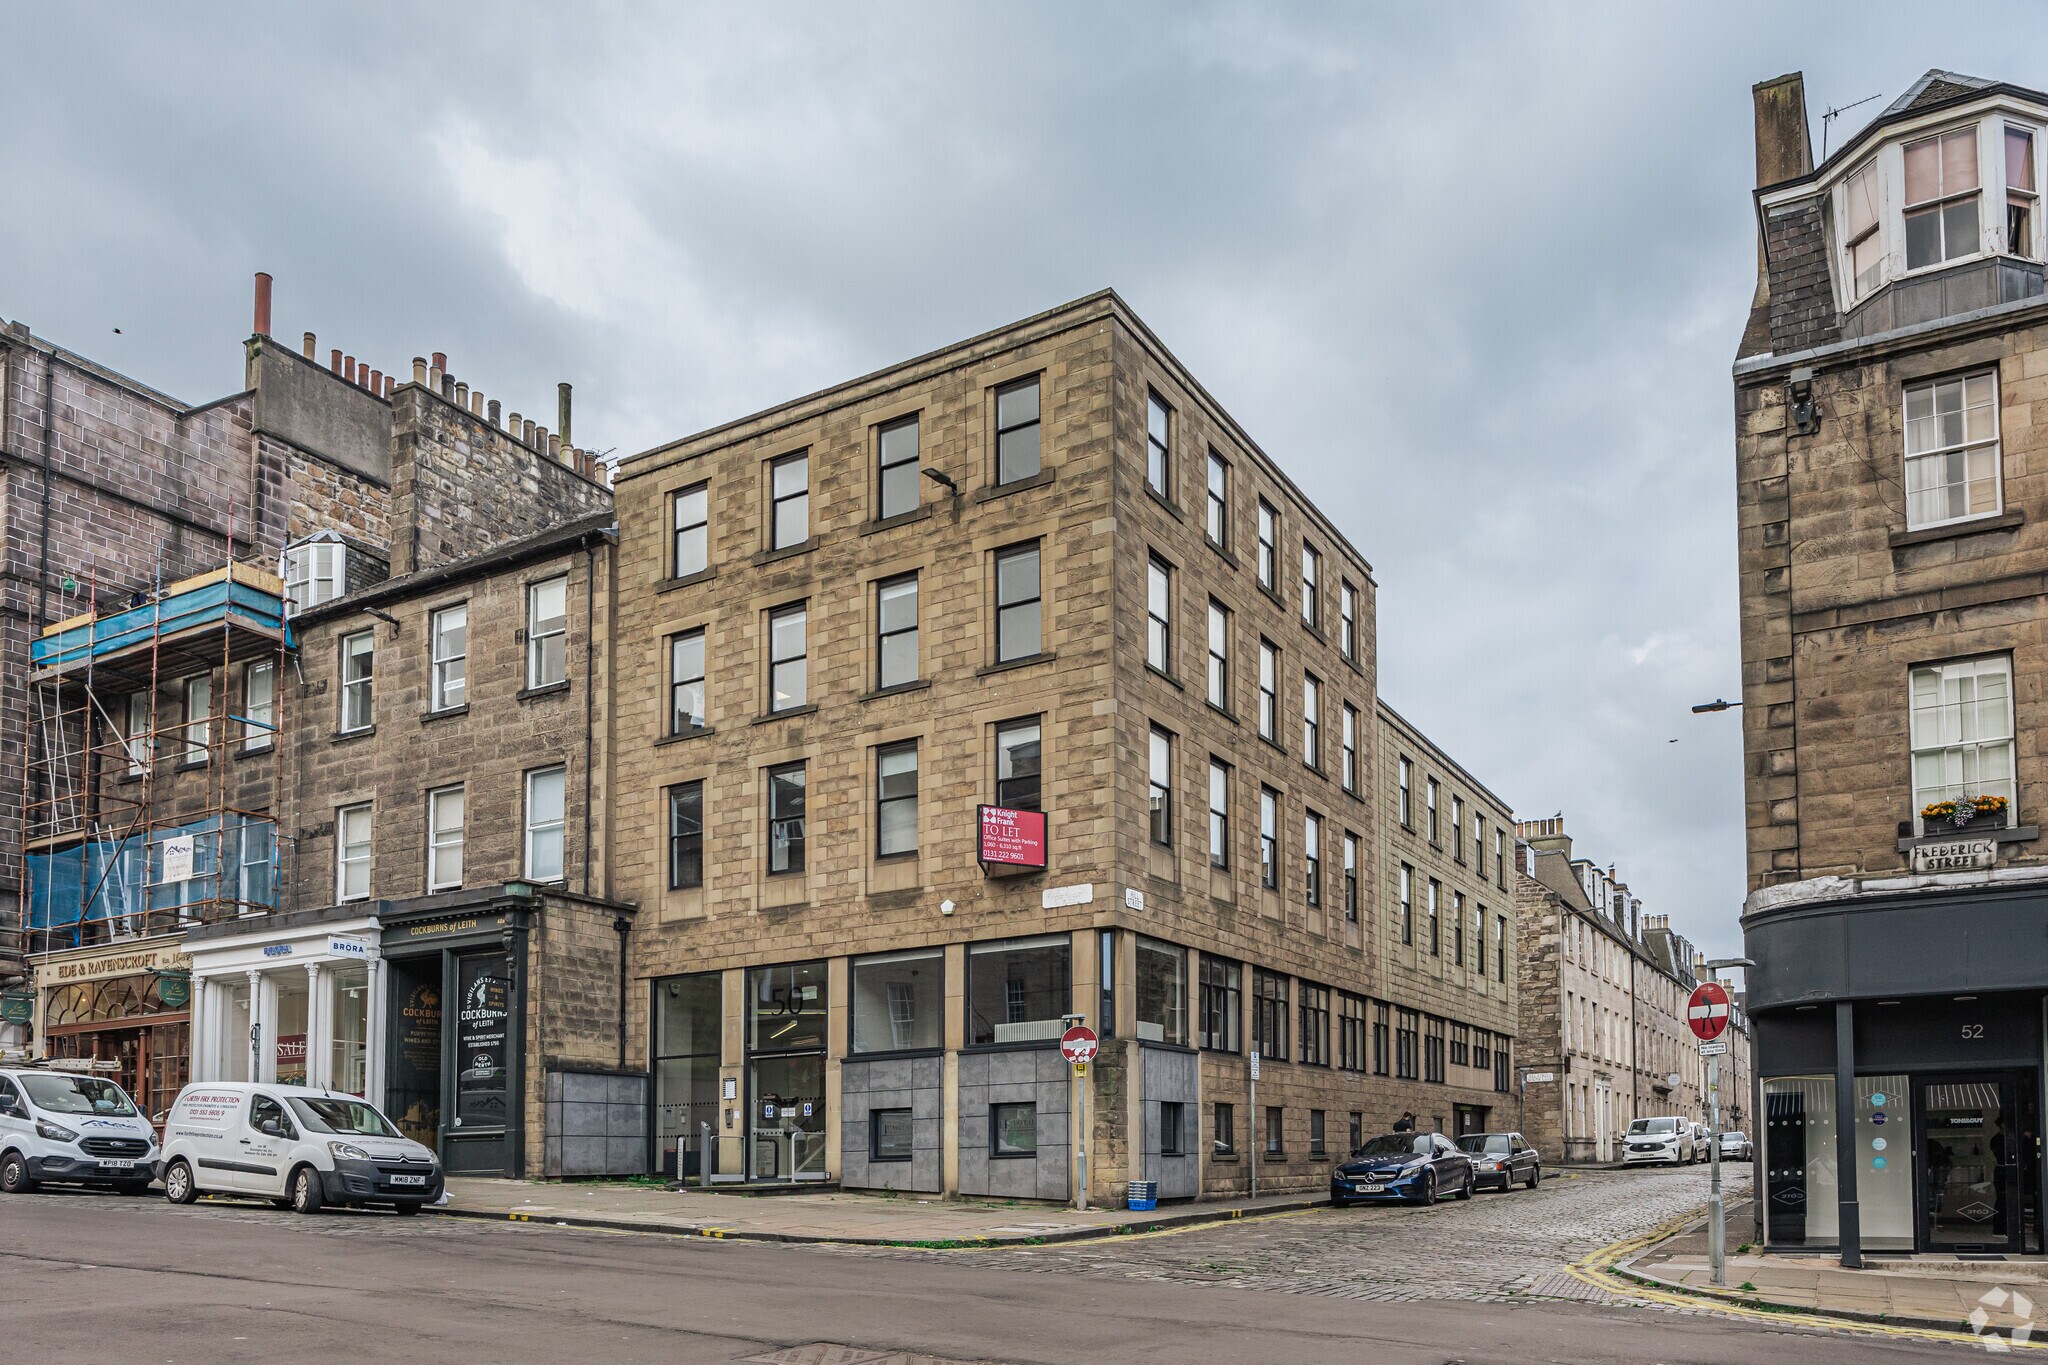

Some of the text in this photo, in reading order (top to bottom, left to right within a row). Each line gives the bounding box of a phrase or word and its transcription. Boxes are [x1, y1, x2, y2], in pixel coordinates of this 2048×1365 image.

[997, 810, 1017, 819] Knight
[997, 817, 1014, 826] Frank
[984, 824, 1020, 837] TO LET
[1914, 843, 1993, 858] FREDERICK
[1928, 855, 1978, 869] STREET
[411, 919, 476, 935] COCKBURNS of LEITH
[333, 943, 364, 953] BRORA
[58, 953, 158, 978] EDE & RAVENSCROFT
[772, 986, 803, 1015] 50
[461, 1009, 507, 1020] COCKBURNS
[473, 1021, 478, 1029] of
[1962, 1024, 1984, 1038] 52
[277, 1040, 306, 1056] SALE
